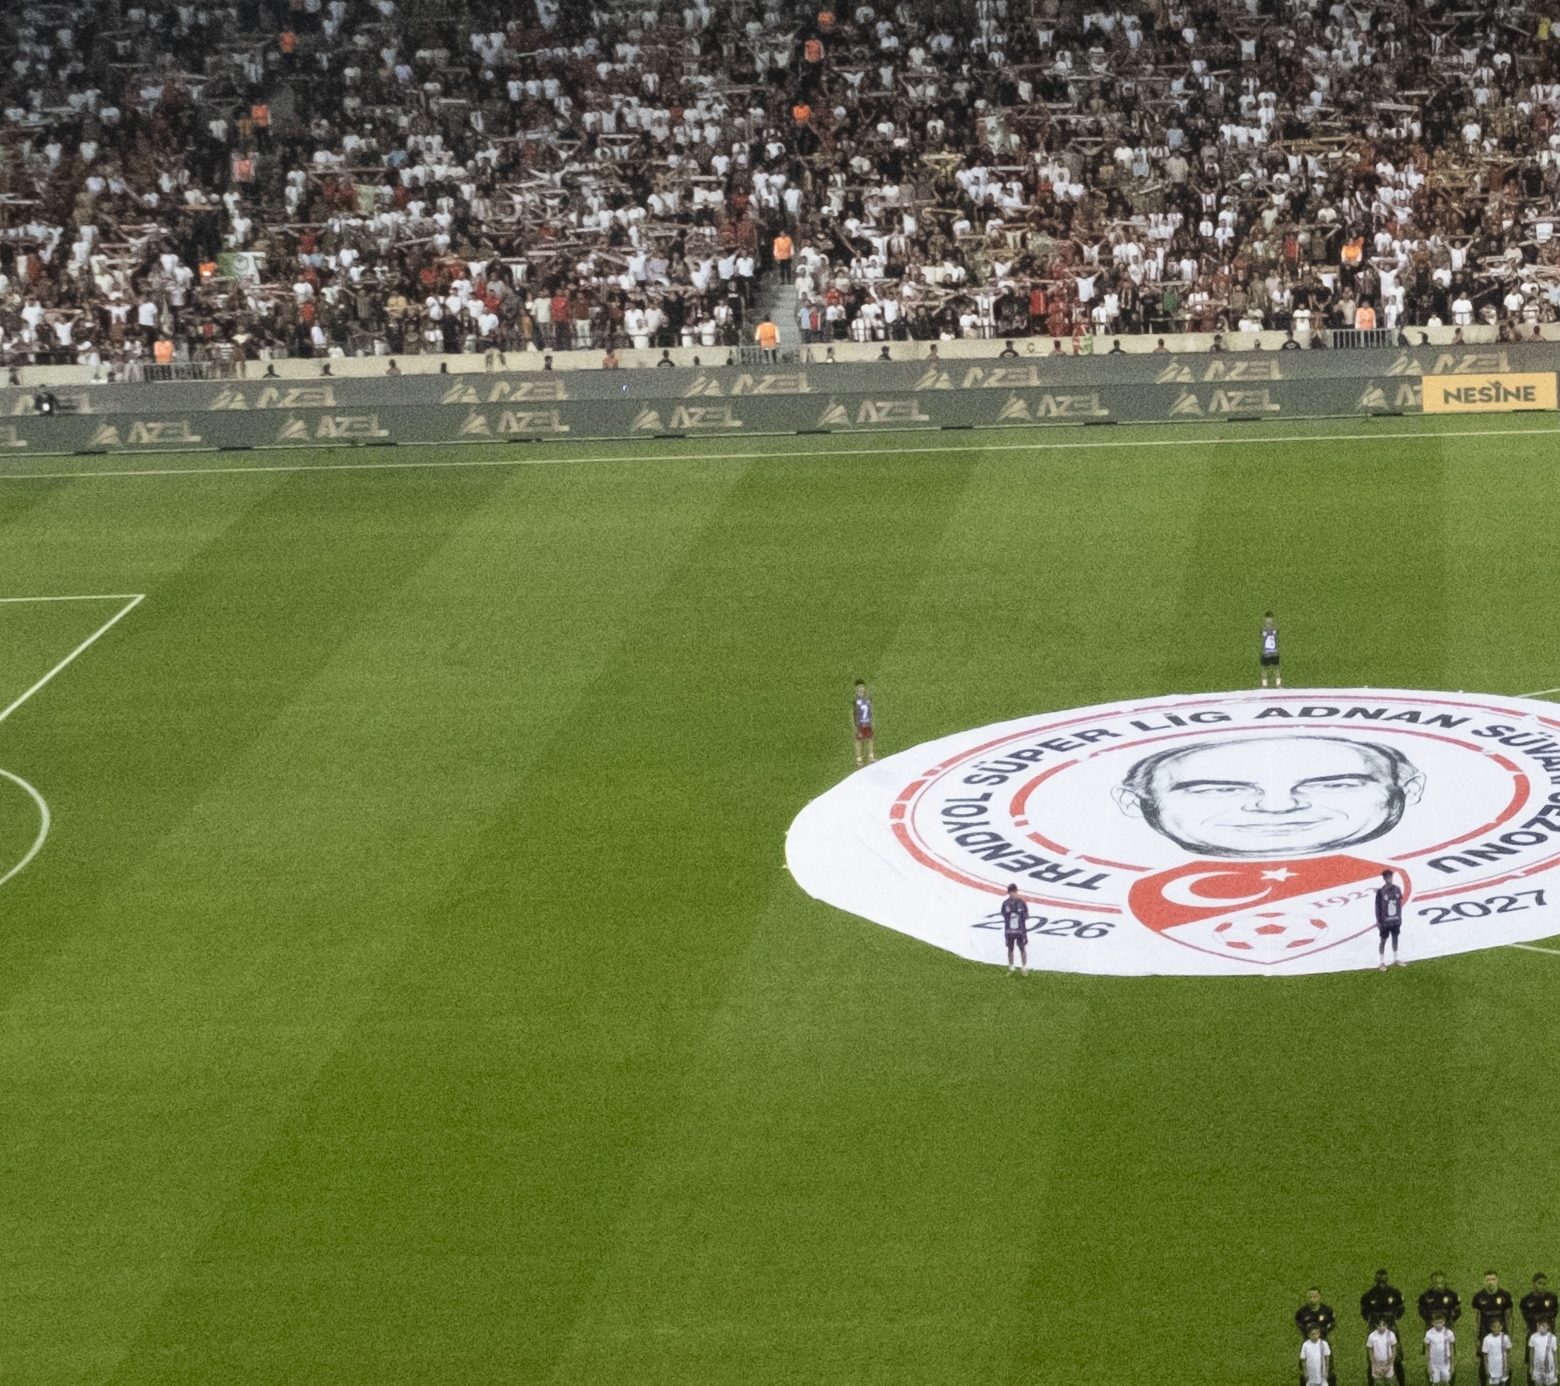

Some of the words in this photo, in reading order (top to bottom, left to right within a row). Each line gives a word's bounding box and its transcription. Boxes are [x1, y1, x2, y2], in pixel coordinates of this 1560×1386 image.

[1204, 361, 1282, 380] AZEL
[1433, 351, 1512, 372] AZEL
[732, 374, 811, 394] AZEL
[963, 367, 1041, 387] AZEL
[257, 388, 336, 407] AZEL
[489, 381, 568, 401] AZEL
[1210, 391, 1280, 412] AZEL
[858, 401, 929, 422] AZEL
[1038, 395, 1109, 416] AZEL
[317, 416, 389, 437] AZEL
[499, 412, 569, 432] AZEL
[671, 407, 742, 428] AZEL
[129, 422, 201, 443] AZEL
[1129, 711, 1233, 733] LİG
[1253, 706, 1474, 730] ADNAN
[962, 728, 1123, 786] SÜPER
[940, 791, 1113, 891] TRENDYOL
[1417, 888, 1548, 925] 2027
